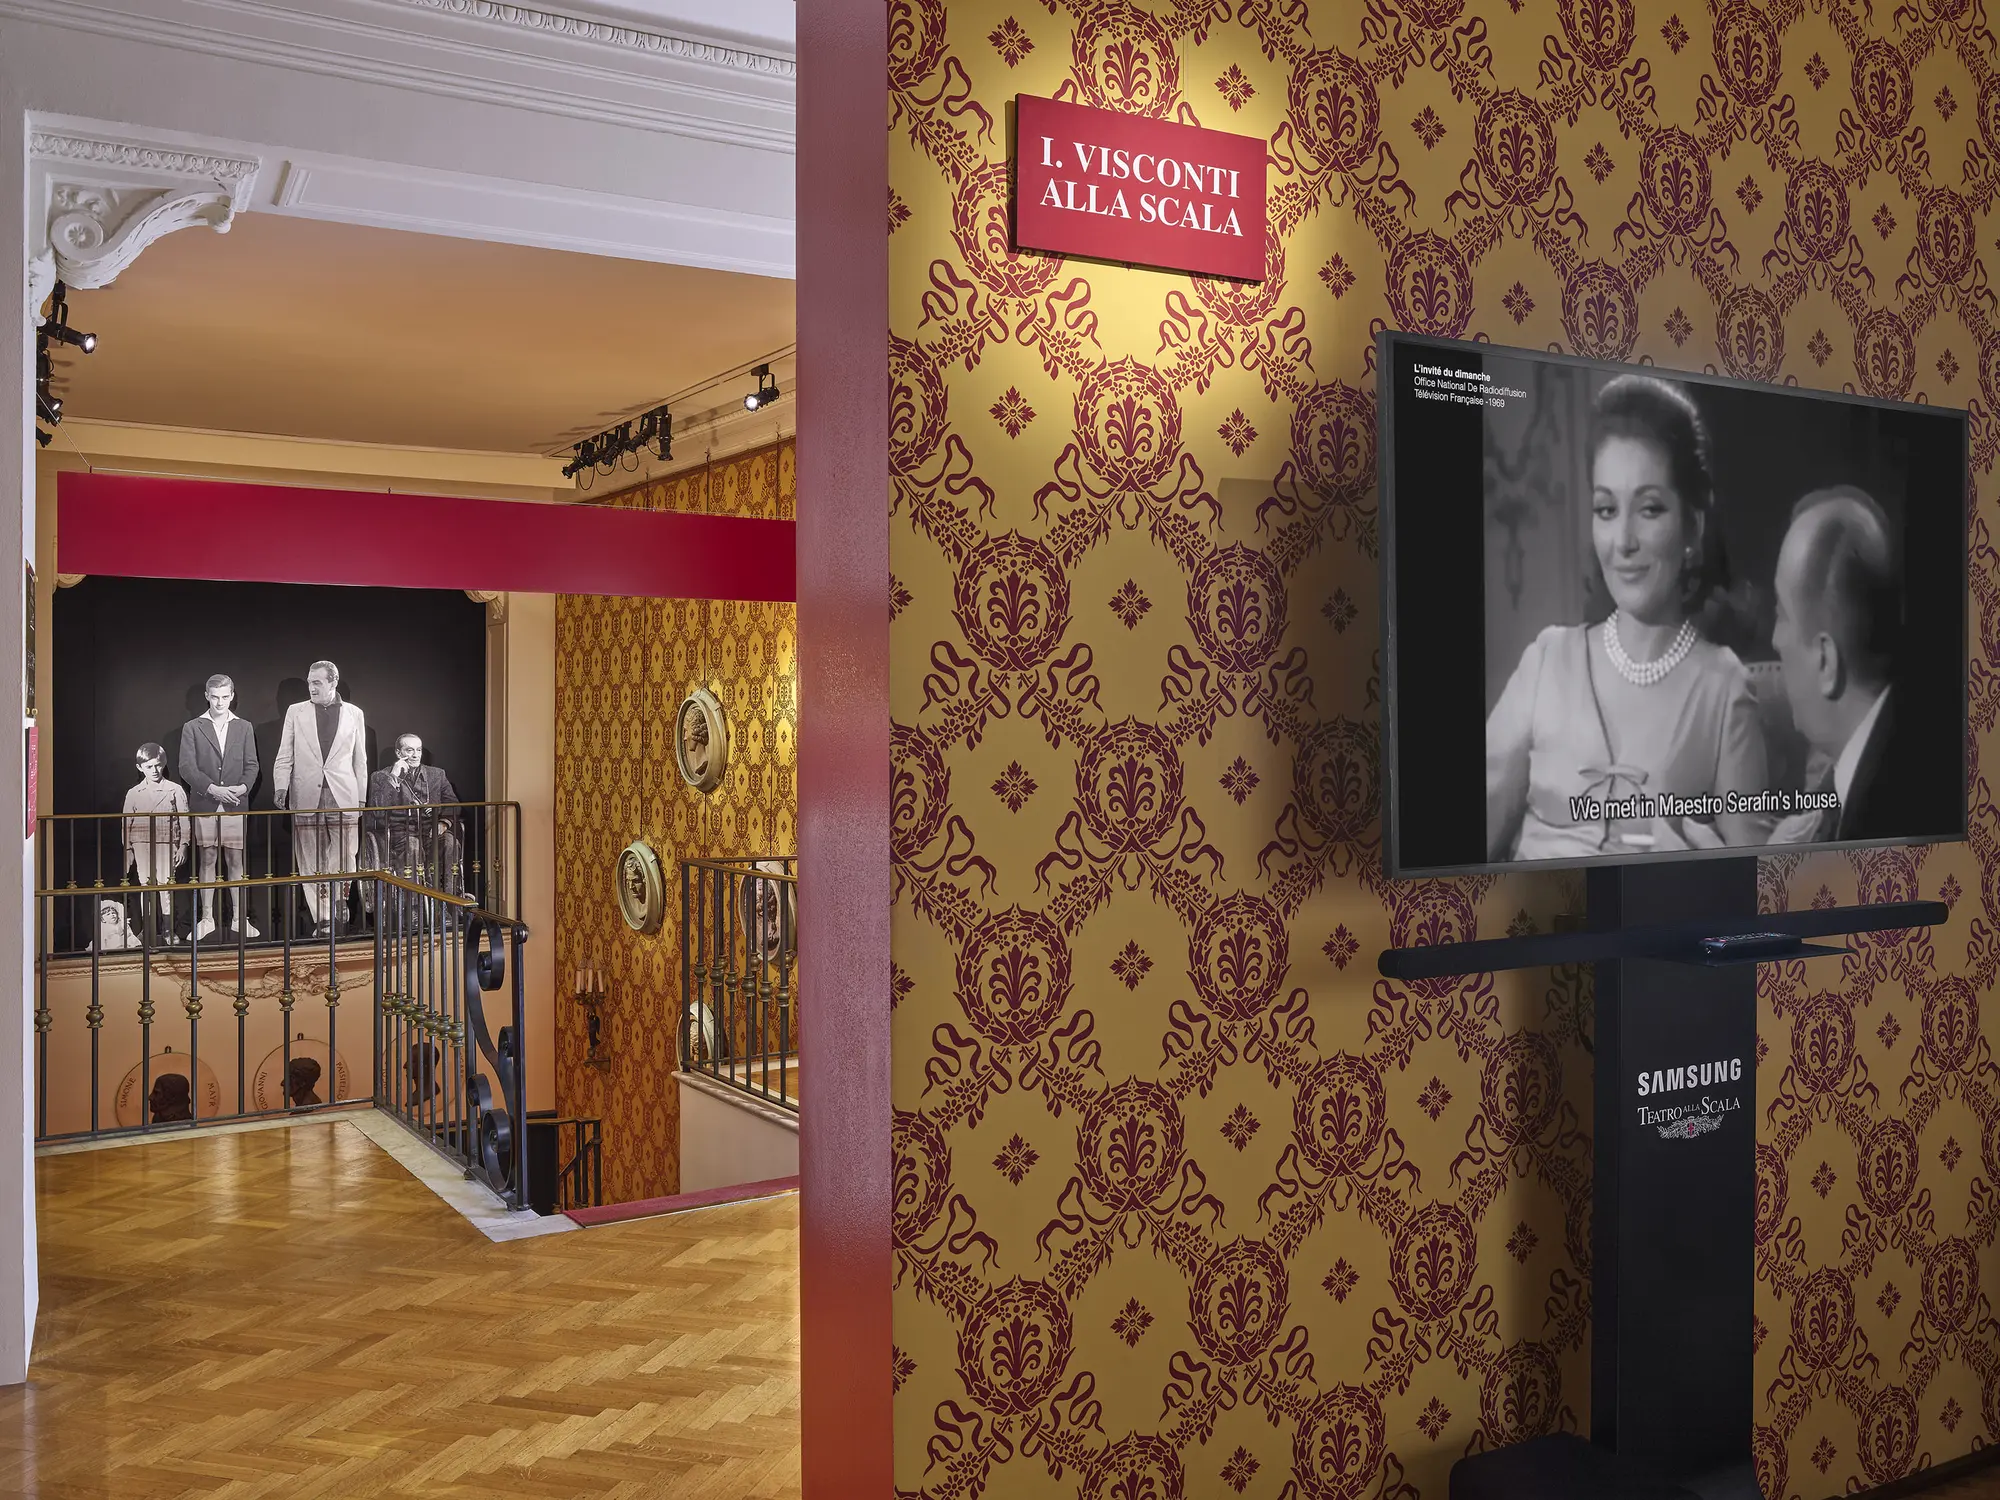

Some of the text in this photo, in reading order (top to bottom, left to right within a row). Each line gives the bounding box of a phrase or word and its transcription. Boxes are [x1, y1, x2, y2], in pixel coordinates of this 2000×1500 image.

[1040, 136, 1241, 199] I. VISCONTI
[1040, 177, 1244, 237] ALLA SCALA
[1413, 363, 1491, 382] L'invité du dimanche
[1413, 376, 1527, 398] Office National De Radiodiffusion
[1413, 388, 1449, 402] Télévision
[1449, 393, 1484, 406] Française
[1570, 789, 1842, 820] We met in Maestro Serafin's house.
[120, 1077, 217, 1109] SIMONE MAYR
[257, 1071, 269, 1110] GIOVANNI
[336, 1061, 347, 1101] PAISIELLO
[1637, 1058, 1742, 1097] SAMSUNG
